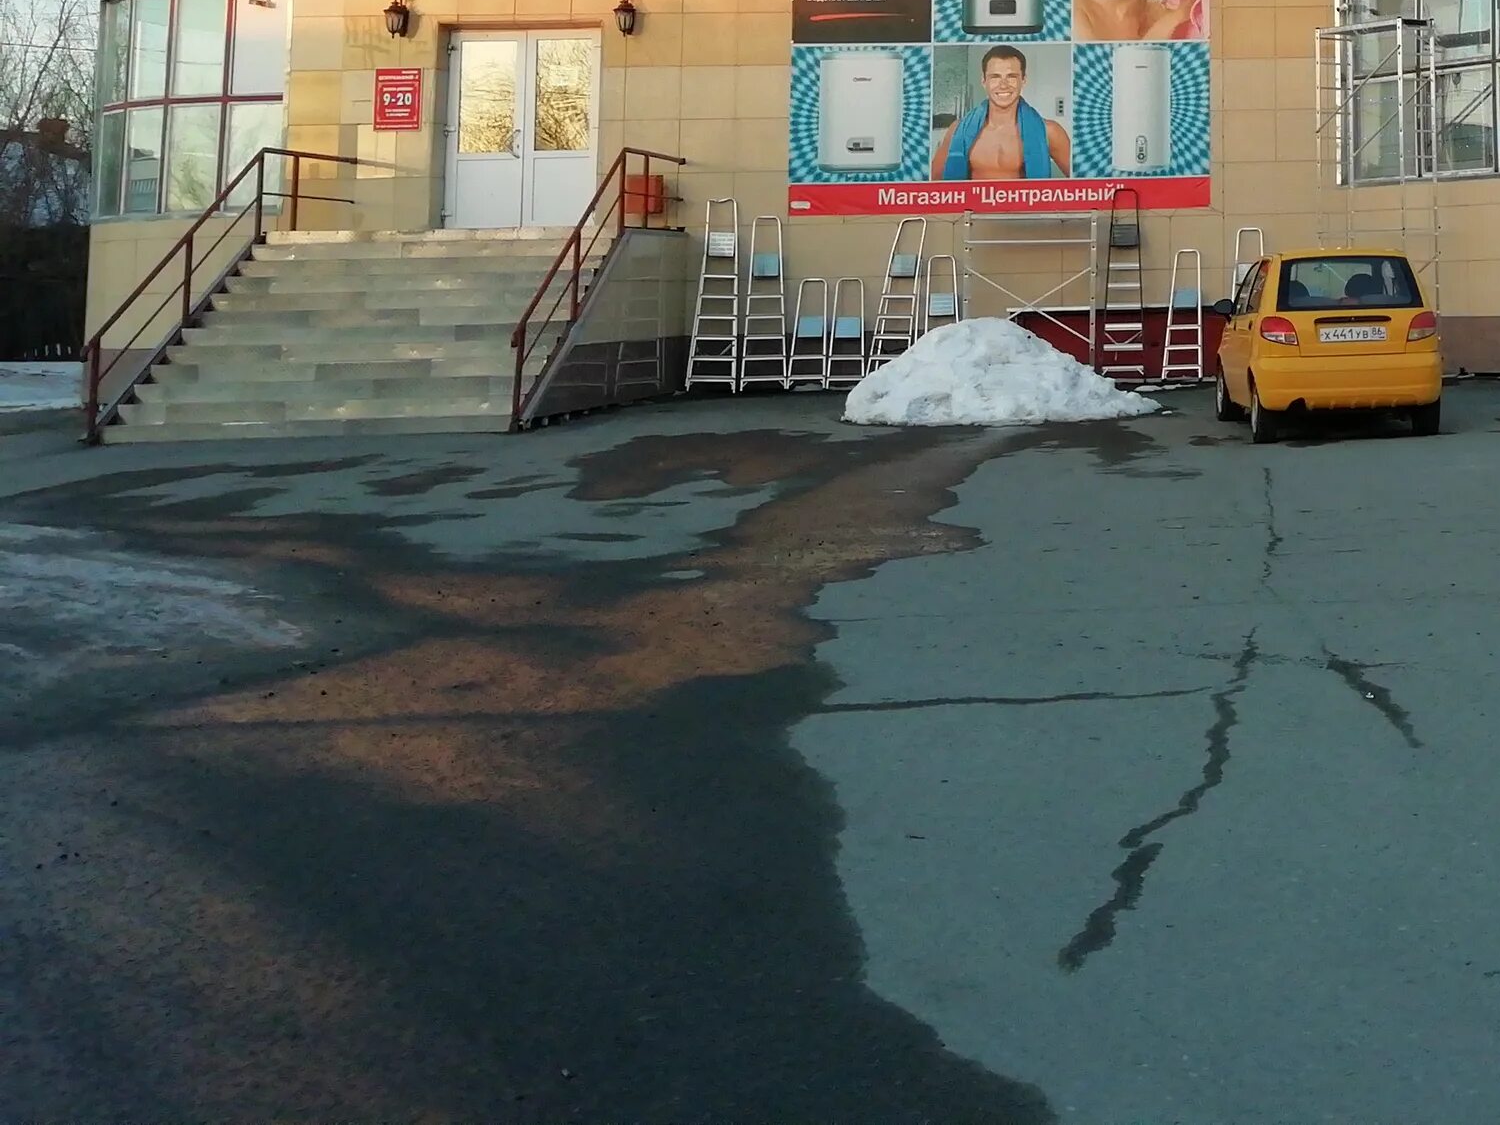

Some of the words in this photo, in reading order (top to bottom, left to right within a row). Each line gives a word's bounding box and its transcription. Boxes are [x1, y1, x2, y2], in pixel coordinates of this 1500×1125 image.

[383, 92, 412, 106] 9-20
[878, 188, 966, 206] Магазин
[972, 183, 1125, 206] "Центральный"
